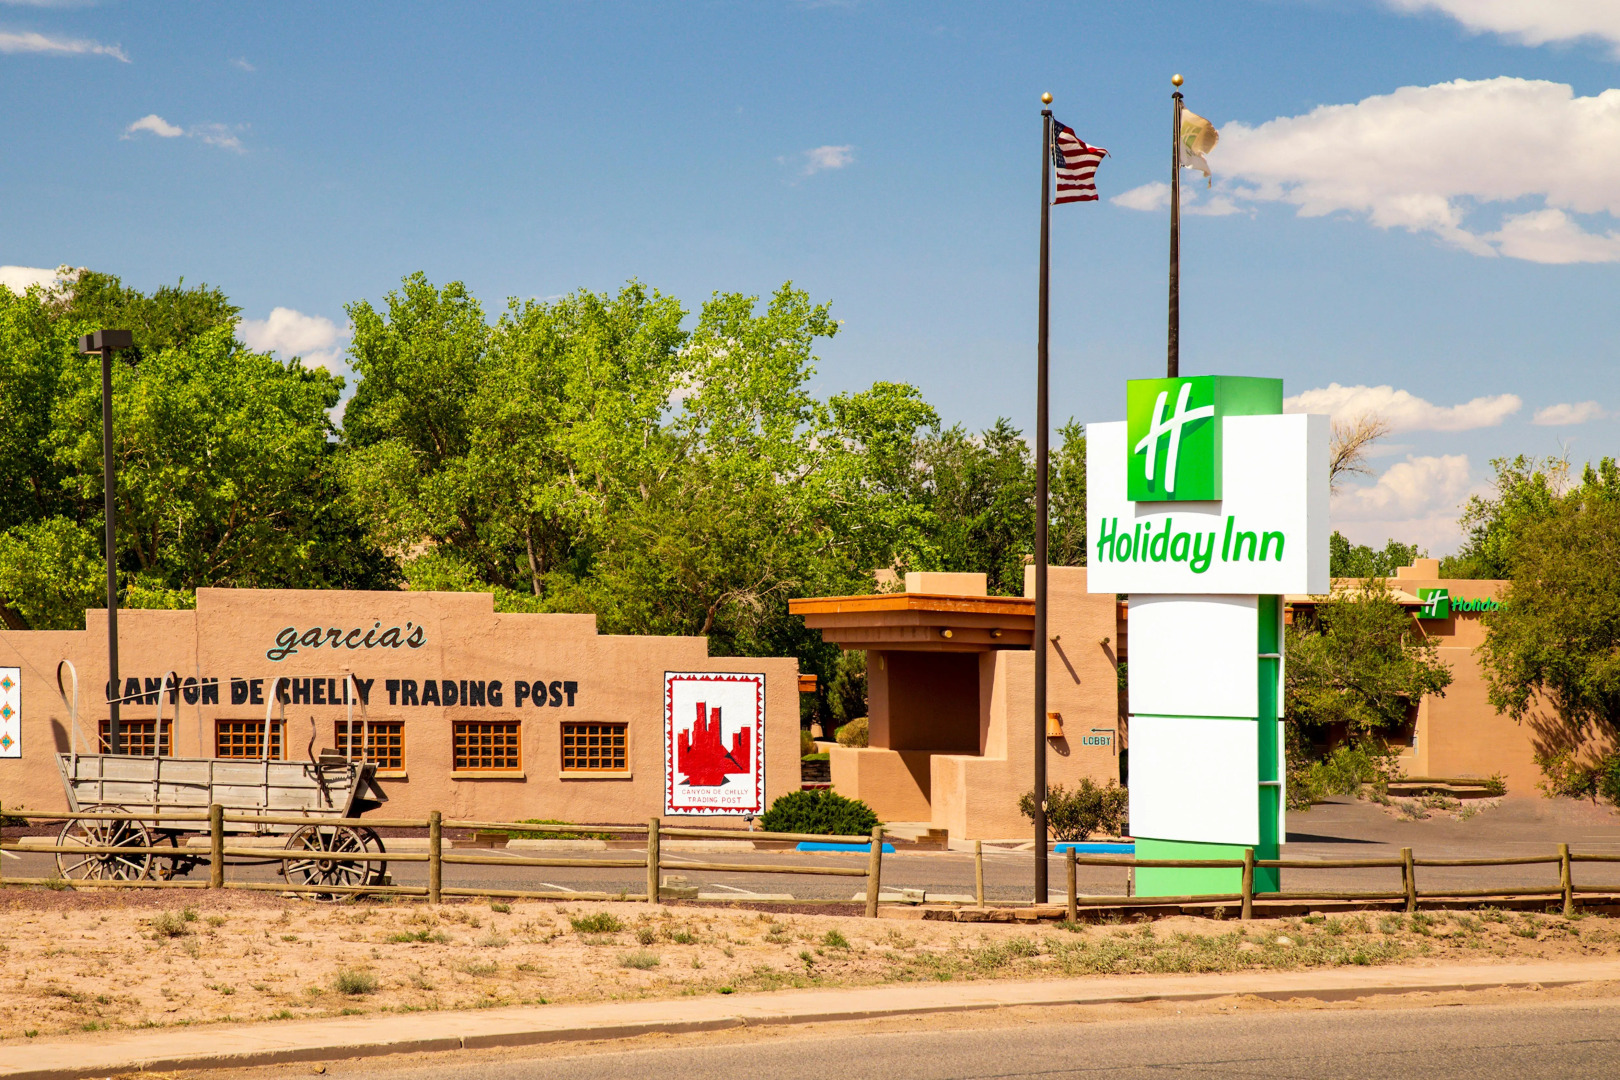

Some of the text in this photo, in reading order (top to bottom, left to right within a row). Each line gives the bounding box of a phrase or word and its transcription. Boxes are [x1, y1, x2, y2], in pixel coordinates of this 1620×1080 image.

[1097, 515, 1285, 574] Holiday Inn
[1451, 596, 1508, 612] Holida
[266, 621, 427, 662] garcia's
[230, 677, 264, 705] DE
[275, 677, 375, 706] CHELLY
[385, 679, 503, 707] TRADING
[514, 681, 578, 707] POST
[1083, 736, 1111, 746] LOBBY
[688, 796, 718, 804] TRADING
